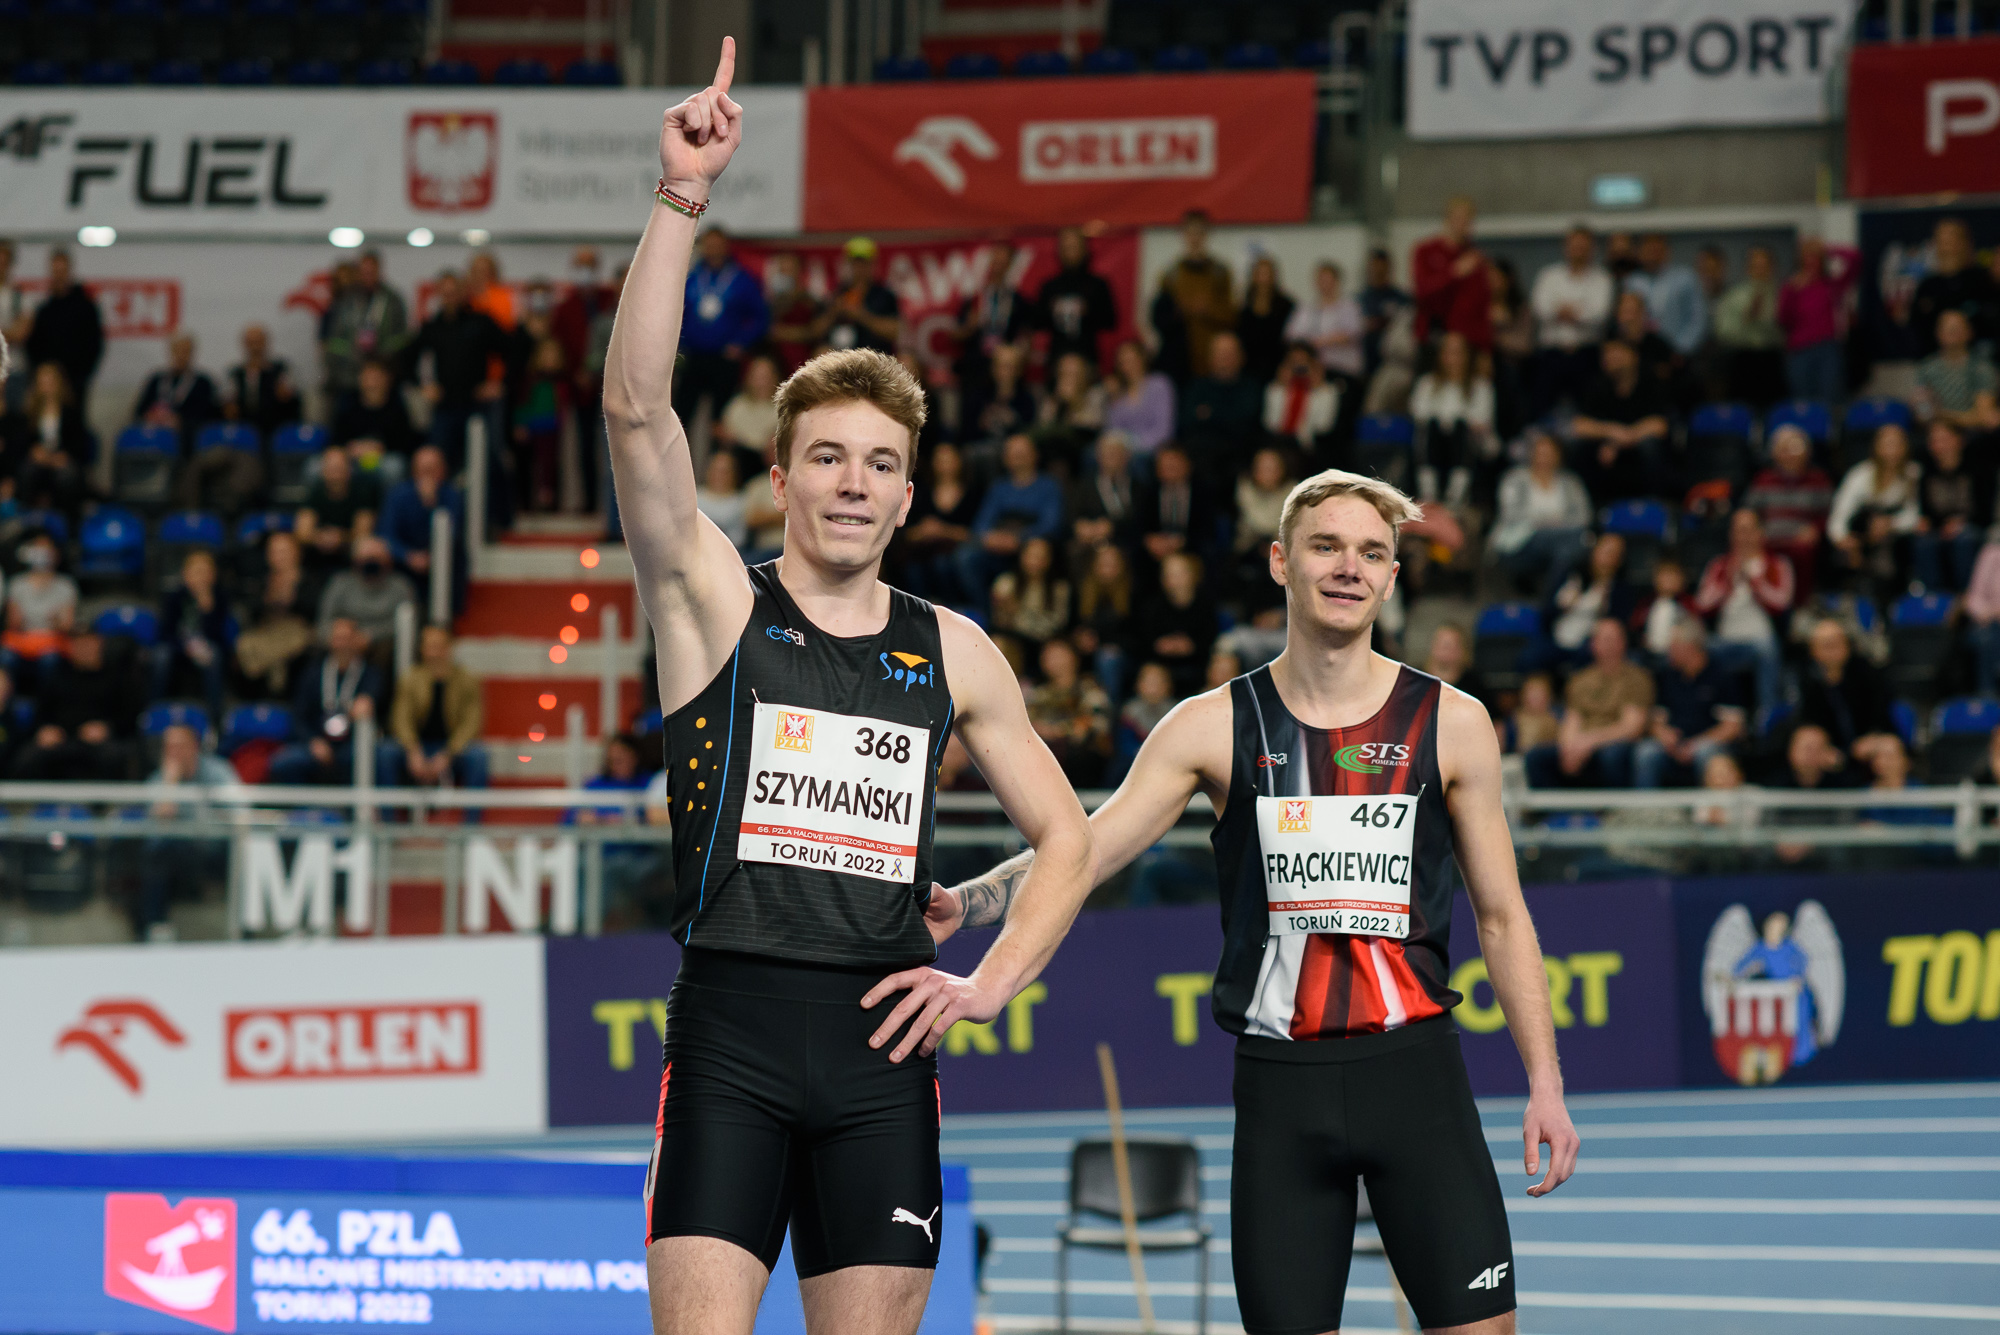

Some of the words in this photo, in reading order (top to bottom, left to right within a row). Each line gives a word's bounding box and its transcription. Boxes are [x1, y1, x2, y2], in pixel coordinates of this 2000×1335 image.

[1425, 27, 1572, 92] TVP
[1592, 13, 1836, 86] SPORT
[1033, 133, 1203, 169] ORLEN
[66, 134, 329, 211] FUEL
[879, 652, 935, 692] Sopot
[777, 736, 809, 751] PZLA
[854, 727, 911, 764] 368
[1359, 742, 1411, 760] STS
[1371, 758, 1410, 767] POMERANIA
[753, 770, 913, 826] SZYMAŃSKI
[1280, 821, 1309, 831] PZLA
[1350, 802, 1409, 829] 467
[757, 826, 771, 834] 66.
[772, 827, 793, 836] PZLA
[794, 829, 824, 841] HALOWE
[825, 834, 875, 849] MISTRZOSTWA
[876, 843, 902, 854] POLSKI
[770, 843, 837, 866] TORUŃ
[843, 853, 885, 875] 2022
[1266, 851, 1410, 889] FRĄCKIEWICZ
[1288, 911, 1342, 930] TORUŃ
[1349, 915, 1390, 932] 2022
[1302, 901, 1330, 909] HALOWE
[1330, 901, 1381, 909] MISTRZOSTWA
[233, 1009, 470, 1074] ORLEN
[251, 1209, 330, 1256] 66.
[338, 1210, 463, 1257] PZLA
[252, 1257, 380, 1289] HALOWE
[384, 1259, 594, 1290] MISTRZOSTWA
[252, 1289, 357, 1322] TORUŃ
[359, 1292, 433, 1324] 2022
